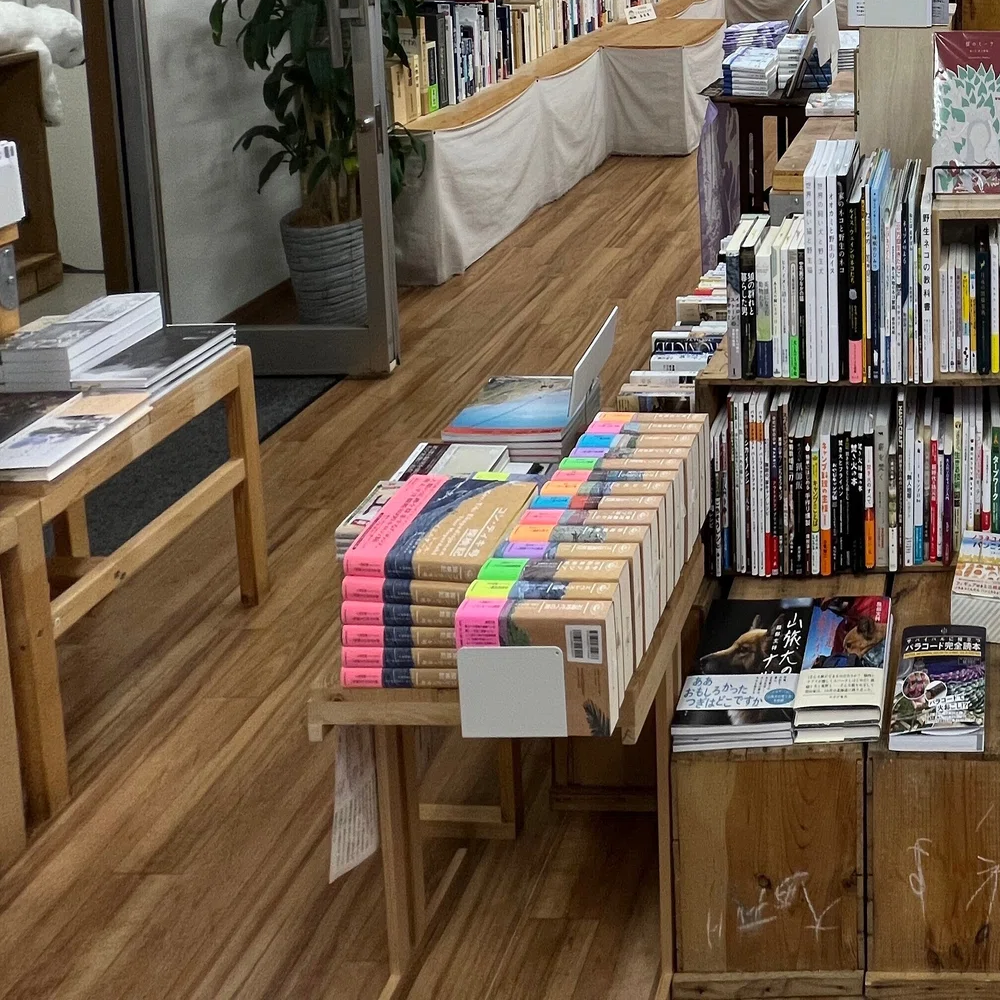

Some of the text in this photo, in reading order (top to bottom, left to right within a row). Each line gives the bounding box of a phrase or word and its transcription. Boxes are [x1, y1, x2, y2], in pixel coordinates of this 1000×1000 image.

[922, 213, 931, 312] 野生ネコの教科書
[905, 641, 982, 652] パラコード完全読本
[692, 676, 713, 687] ああ
[684, 682, 748, 698] おもしろかった
[686, 695, 764, 709] つぎはどこですか
